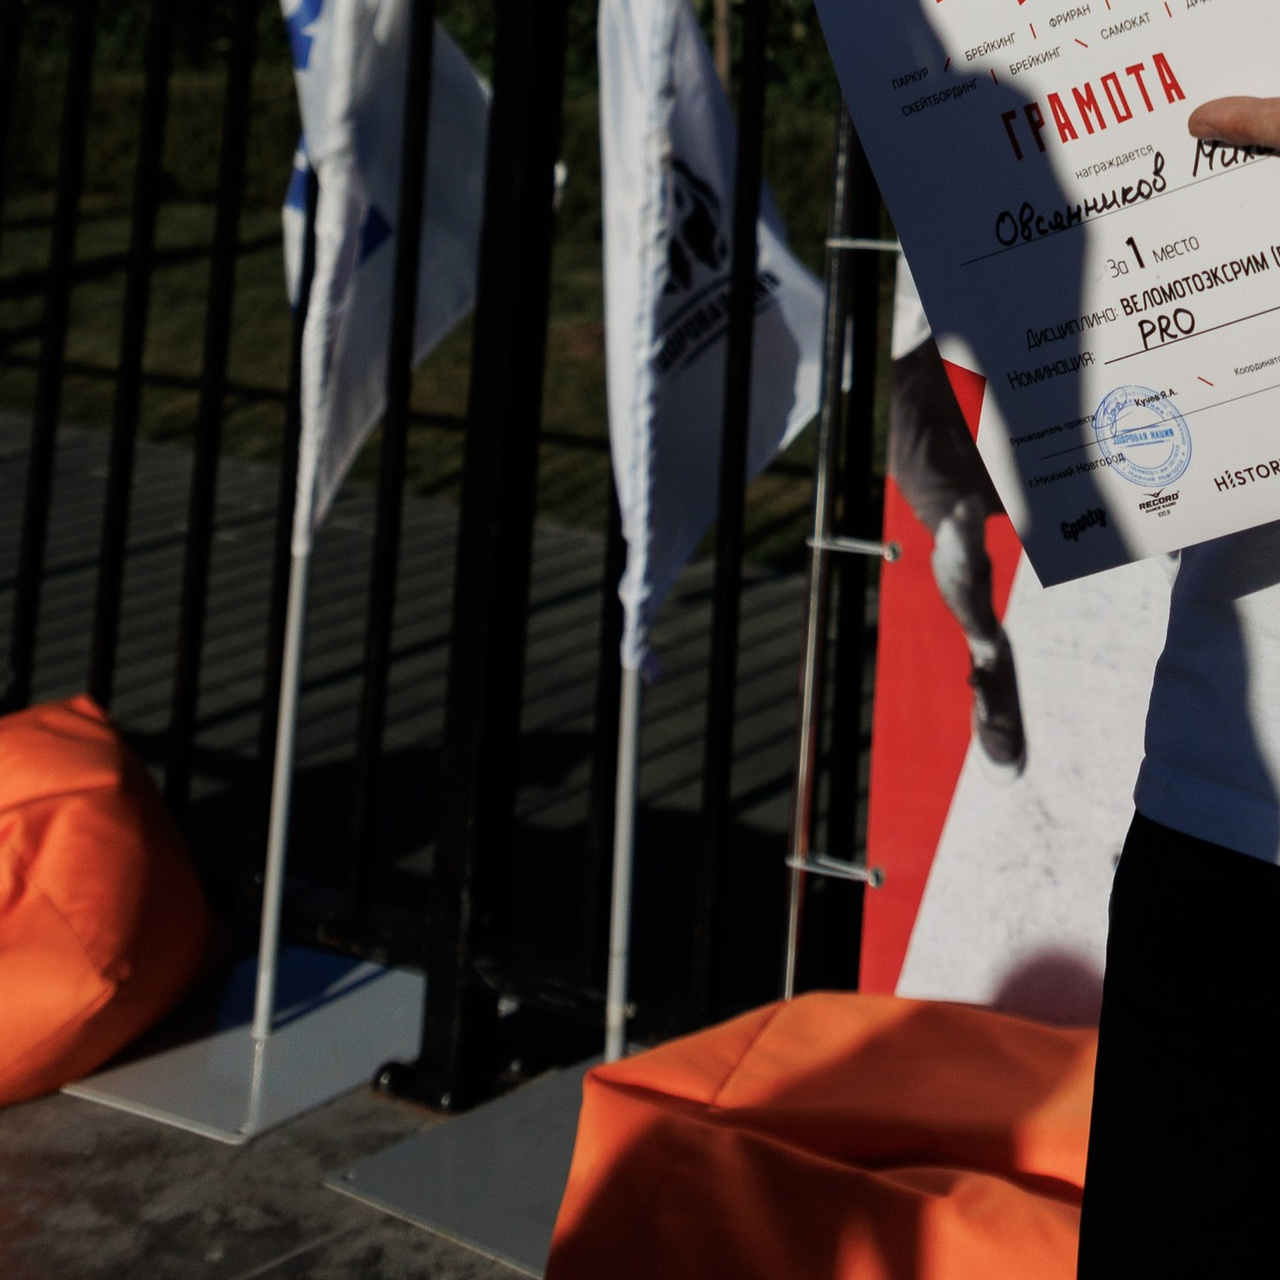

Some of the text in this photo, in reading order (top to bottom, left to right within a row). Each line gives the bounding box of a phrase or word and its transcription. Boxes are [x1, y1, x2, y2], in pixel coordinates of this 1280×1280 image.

[891, 67, 930, 91] ПАРКУР
[964, 31, 1018, 63] БРЕЙКИНГ
[1048, 3, 1092, 30] ФРИРАН
[900, 76, 979, 118] СКЕЙТБОРДИНГ
[1008, 45, 1063, 76] БРЕЙКИНГ
[1100, 11, 1152, 41] САМОКАТ
[1001, 52, 1187, 161] ГРАМОТА
[1074, 144, 1156, 181] награждается
[1106, 235, 1201, 279] За 1 место
[1026, 305, 1119, 351] Дисциплина:
[1120, 251, 1271, 318] ВЕЛОМОТОЭКСРИМ
[1006, 307, 1197, 390] Номинация: PRO
[1076, 451, 1127, 476] Новгород
[1139, 492, 1179, 511] RECORD
